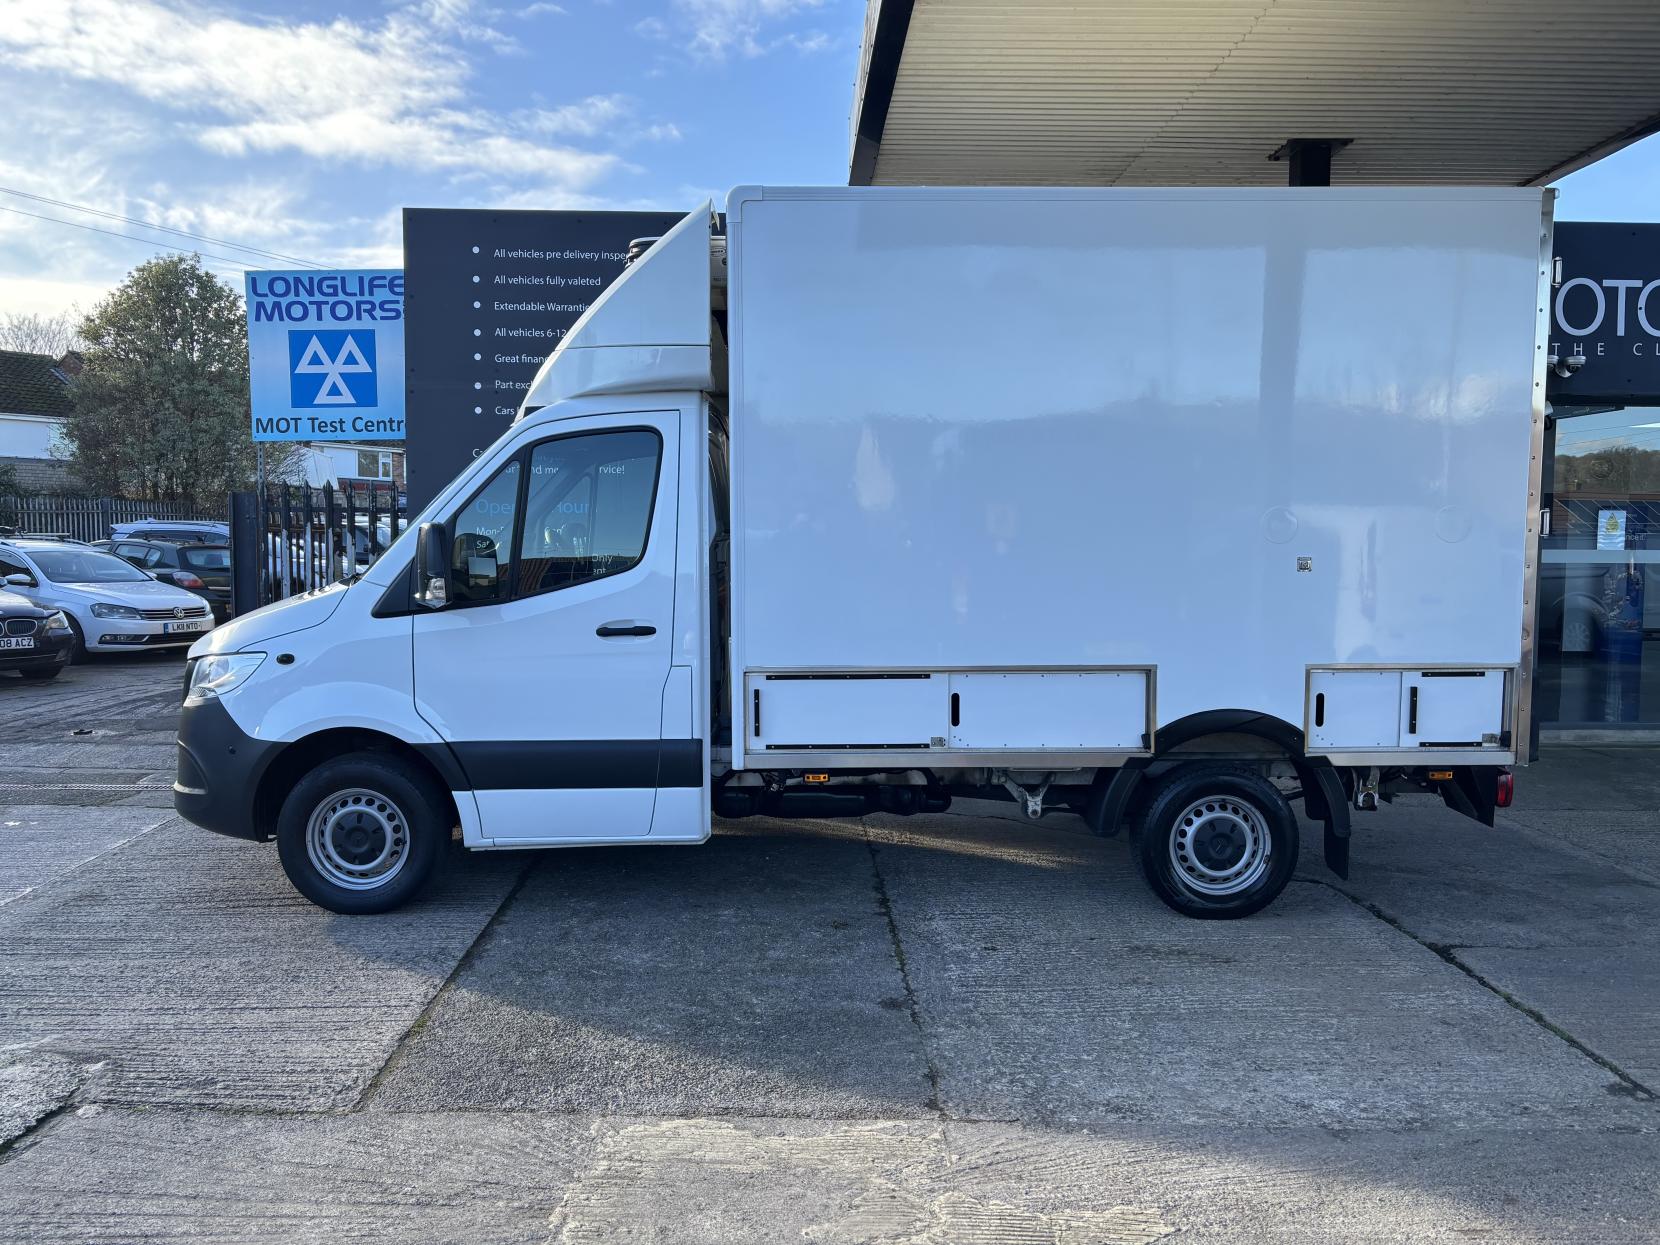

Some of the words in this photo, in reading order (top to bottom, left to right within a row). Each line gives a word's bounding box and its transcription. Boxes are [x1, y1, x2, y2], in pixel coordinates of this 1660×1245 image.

[494, 249, 506, 259] All
[507, 249, 544, 260] vehicles
[546, 252, 562, 261] pre
[563, 250, 600, 262] delivery
[601, 251, 627, 262] Inspe
[250, 275, 404, 298] LONGLIFE
[494, 275, 506, 285] All
[507, 275, 544, 285] vehicles
[546, 276, 565, 288] fully
[567, 276, 601, 286] valeted
[254, 299, 402, 322] MOTORS
[494, 301, 545, 312] Extendable
[494, 328, 506, 337] All
[508, 328, 545, 338] vehicles
[546, 329, 567, 338] 6-12
[1551, 342, 1605, 356] THE
[494, 354, 519, 364] Great
[495, 380, 513, 389] Part
[495, 406, 515, 415] Cars
[255, 417, 302, 434] MOT
[307, 416, 346, 433] Test
[351, 416, 406, 432] Centr
[15, 637, 33, 648] ACZ
